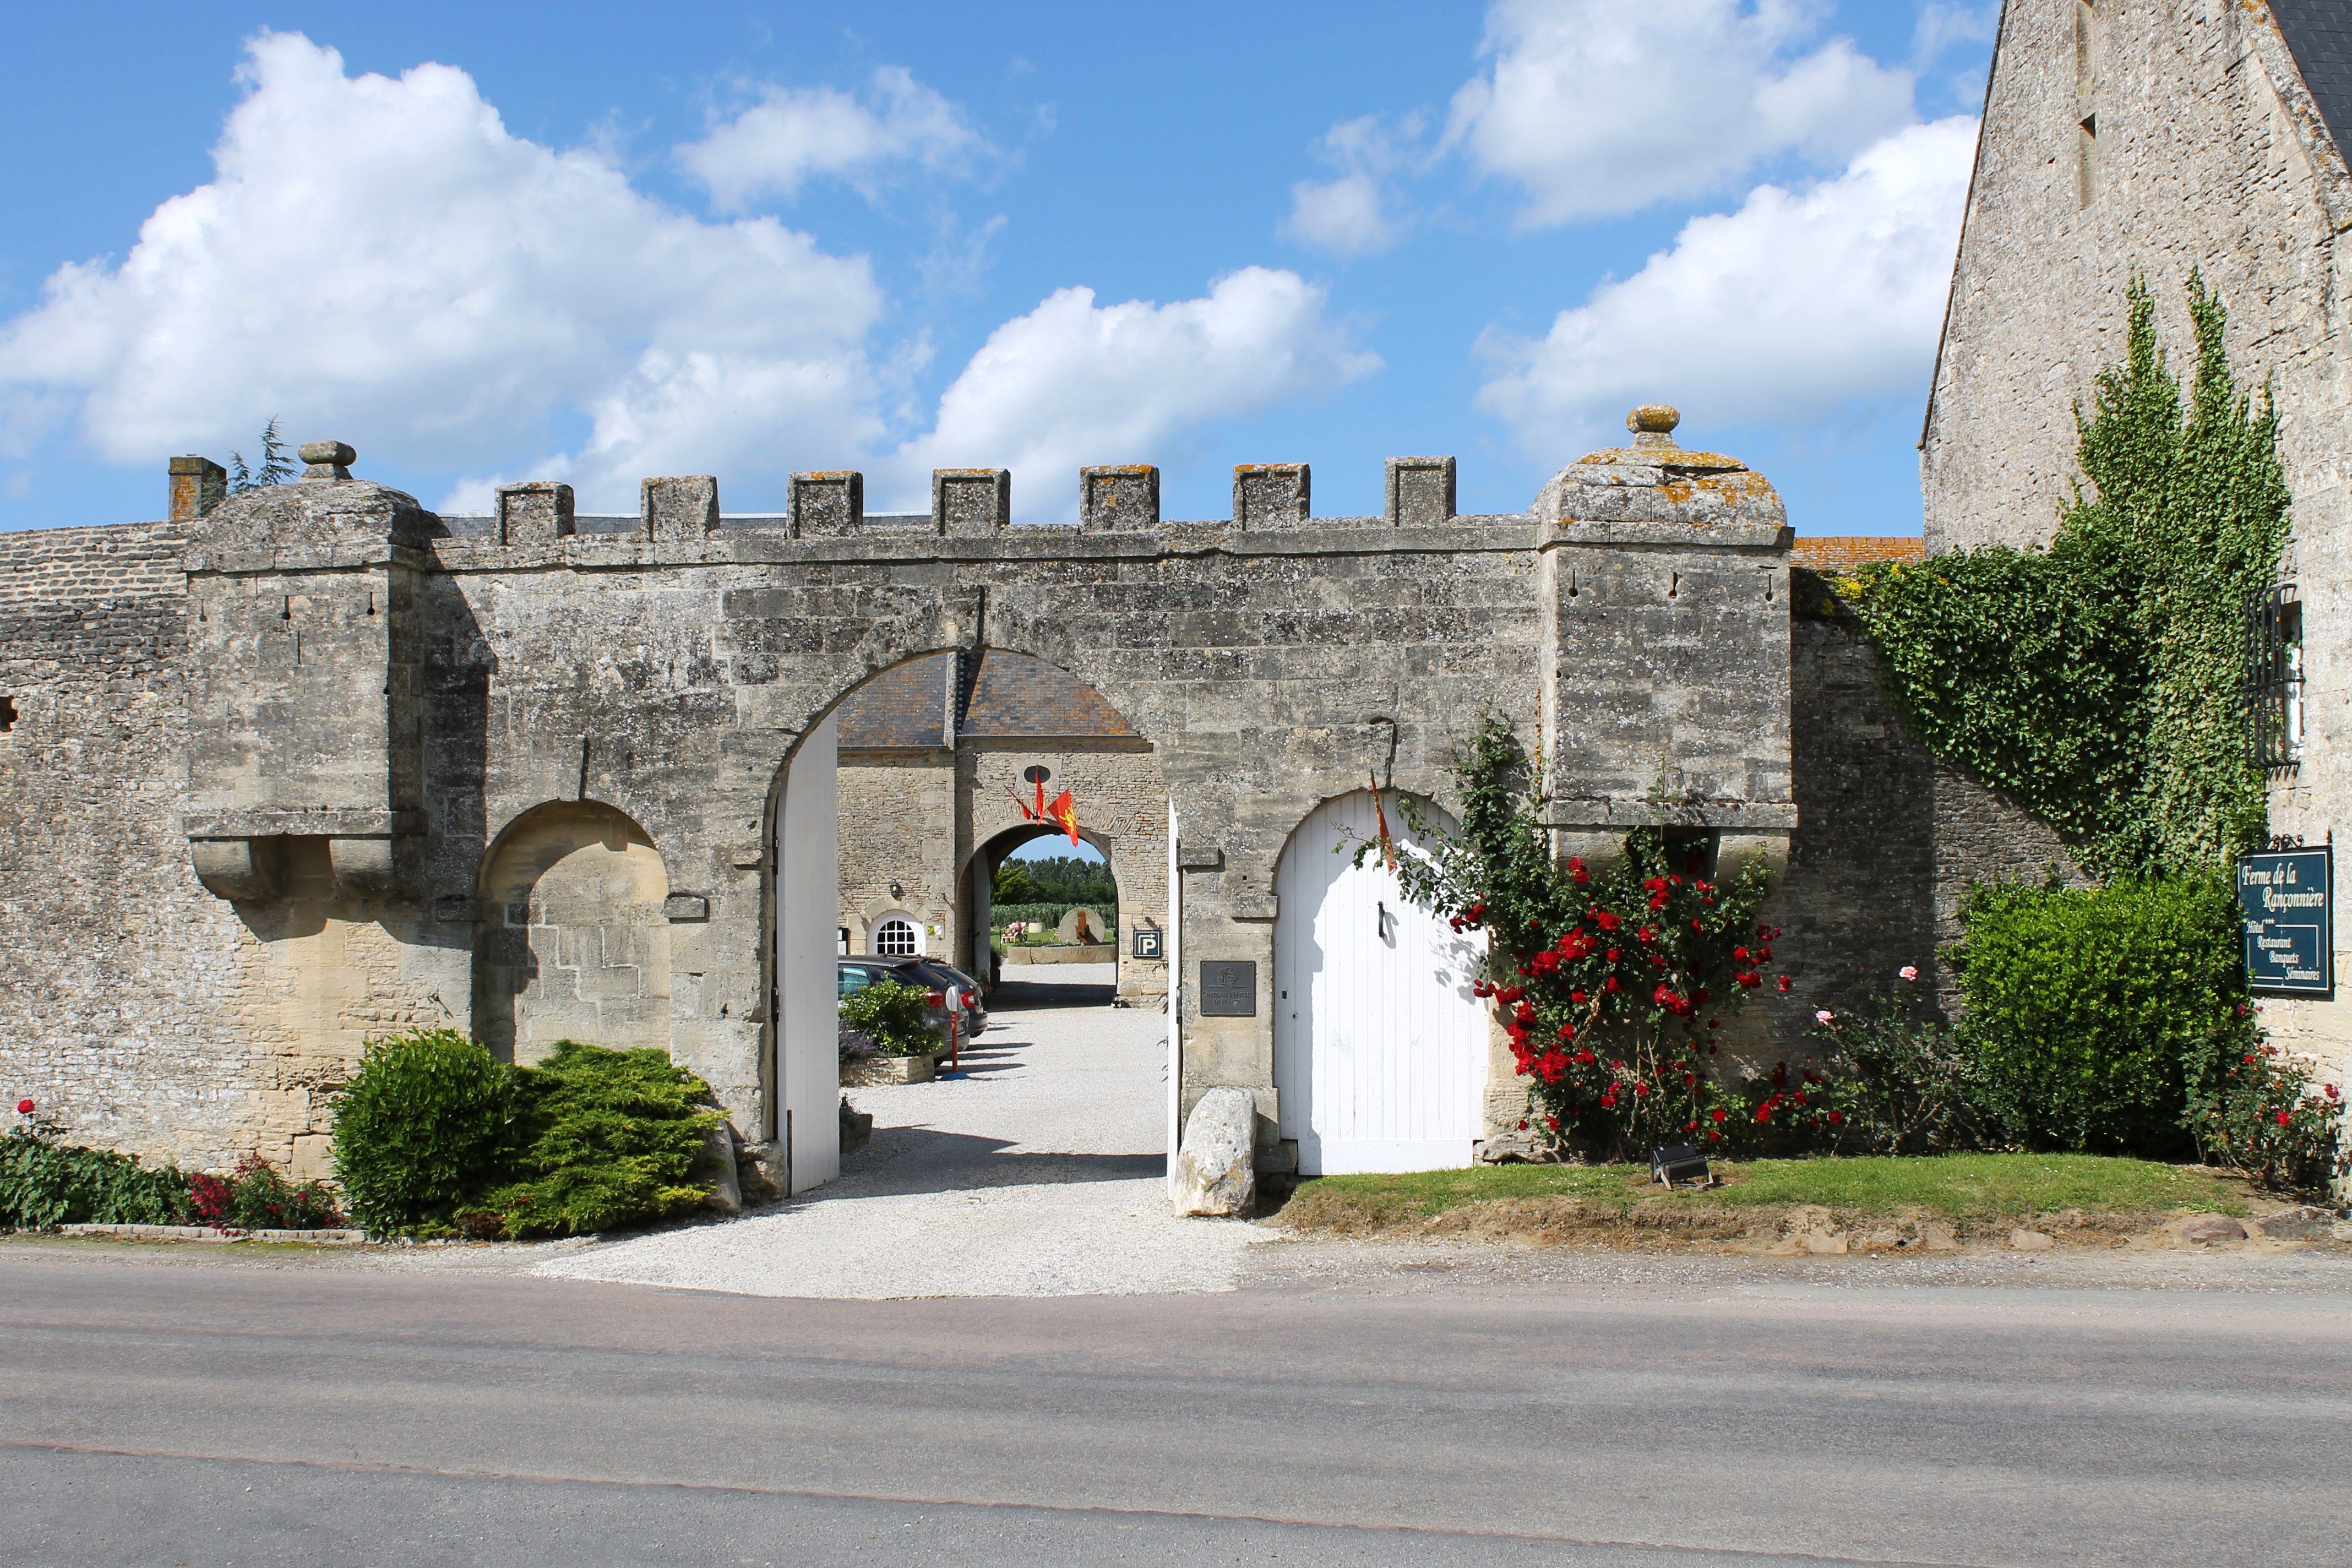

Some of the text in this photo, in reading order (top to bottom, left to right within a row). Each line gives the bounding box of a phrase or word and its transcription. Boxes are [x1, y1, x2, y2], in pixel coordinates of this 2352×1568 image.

[2242, 862, 2297, 885] Ferme de la
[2262, 886, 2324, 913] Rançonnière
[1143, 939, 1156, 954] P
[2257, 935, 2291, 950] Restaurant
[2269, 950, 2299, 968] Banquets
[2285, 966, 2320, 981] Séminaires
